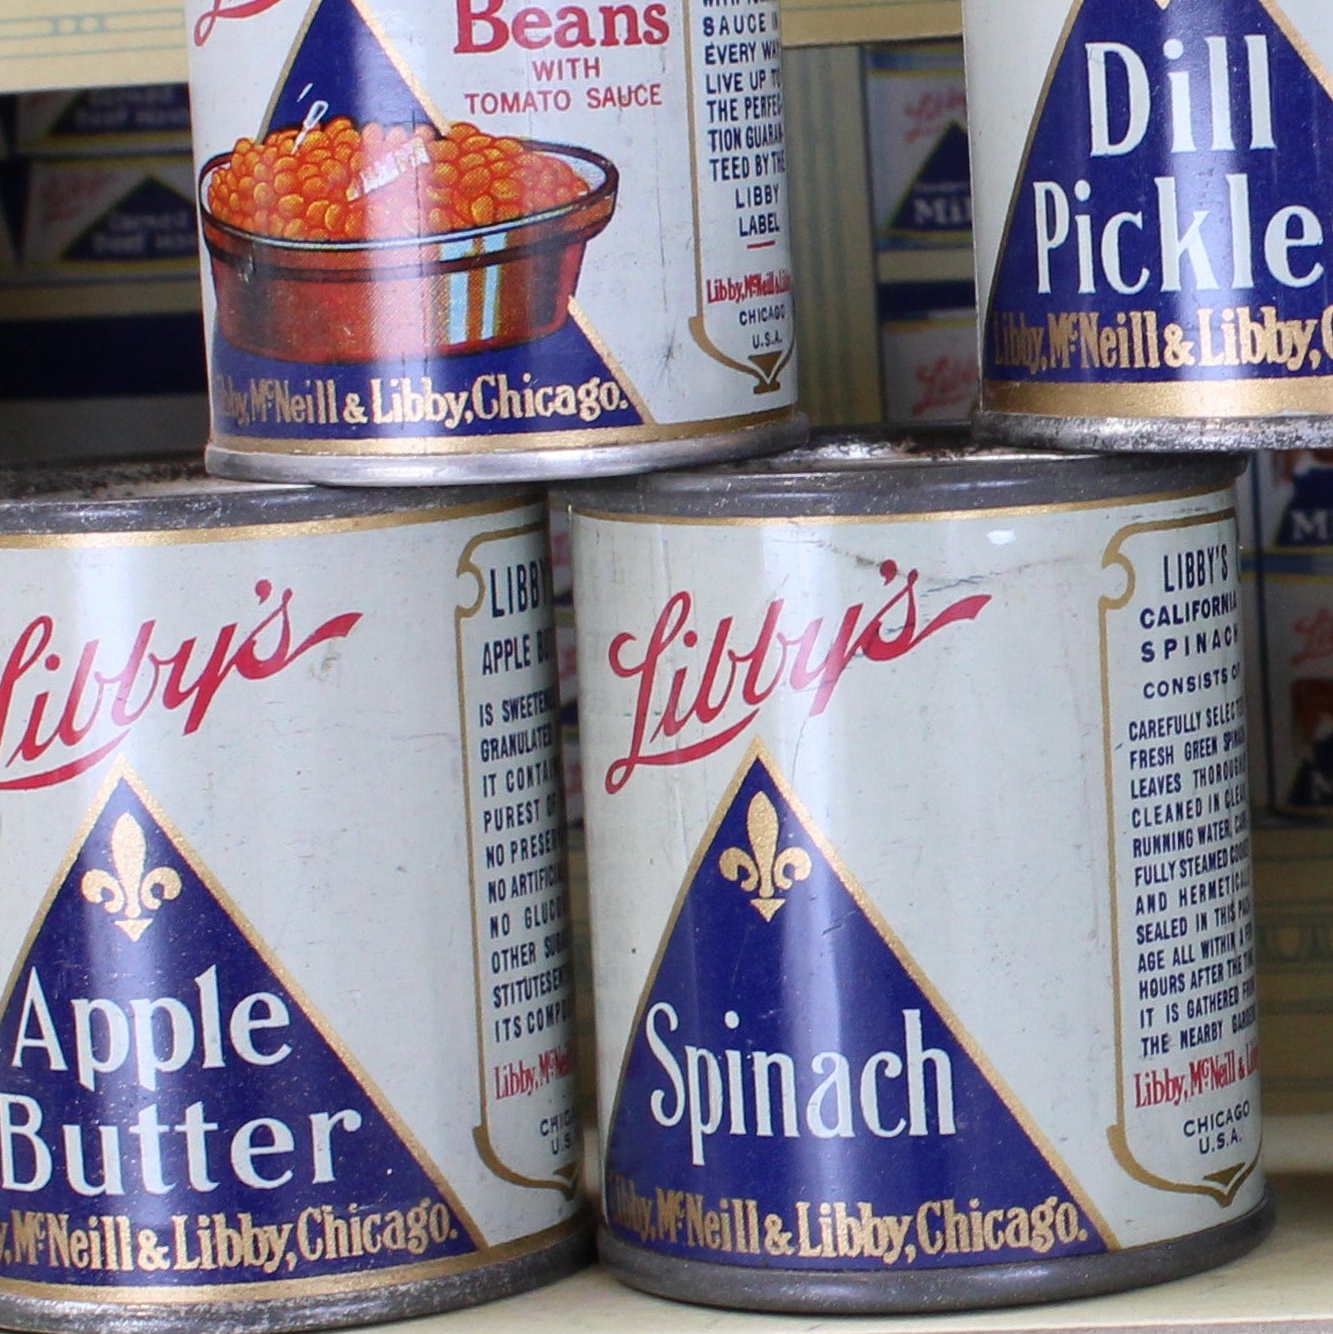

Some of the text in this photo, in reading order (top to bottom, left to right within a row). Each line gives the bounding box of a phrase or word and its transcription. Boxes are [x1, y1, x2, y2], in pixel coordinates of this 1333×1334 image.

[532, 57, 602, 80] WITH
[704, 41, 757, 66] EVERY
[464, 83, 663, 117] TOMATO SAUCE
[1085, 35, 1276, 157] Dill
[735, 183, 780, 209] LIBBY
[738, 212, 781, 238] LABEL
[1163, 331, 1195, 369] &
[1199, 310, 1322, 378] Libby,
[1162, 543, 1229, 593] LIBBY'S
[1139, 590, 1238, 630] CALIFORNIA
[604, 559, 992, 796] Libby's
[1128, 710, 1202, 742] CAREFULLY
[1132, 827, 1194, 859] RUNNING
[14, 965, 292, 1093] Apple
[644, 1002, 958, 1165] Spinach
[1182, 1098, 1251, 1139] CHICAGO
[3, 1092, 362, 1195] Butter
[172, 1196, 459, 1274] Libby, Chicago.
